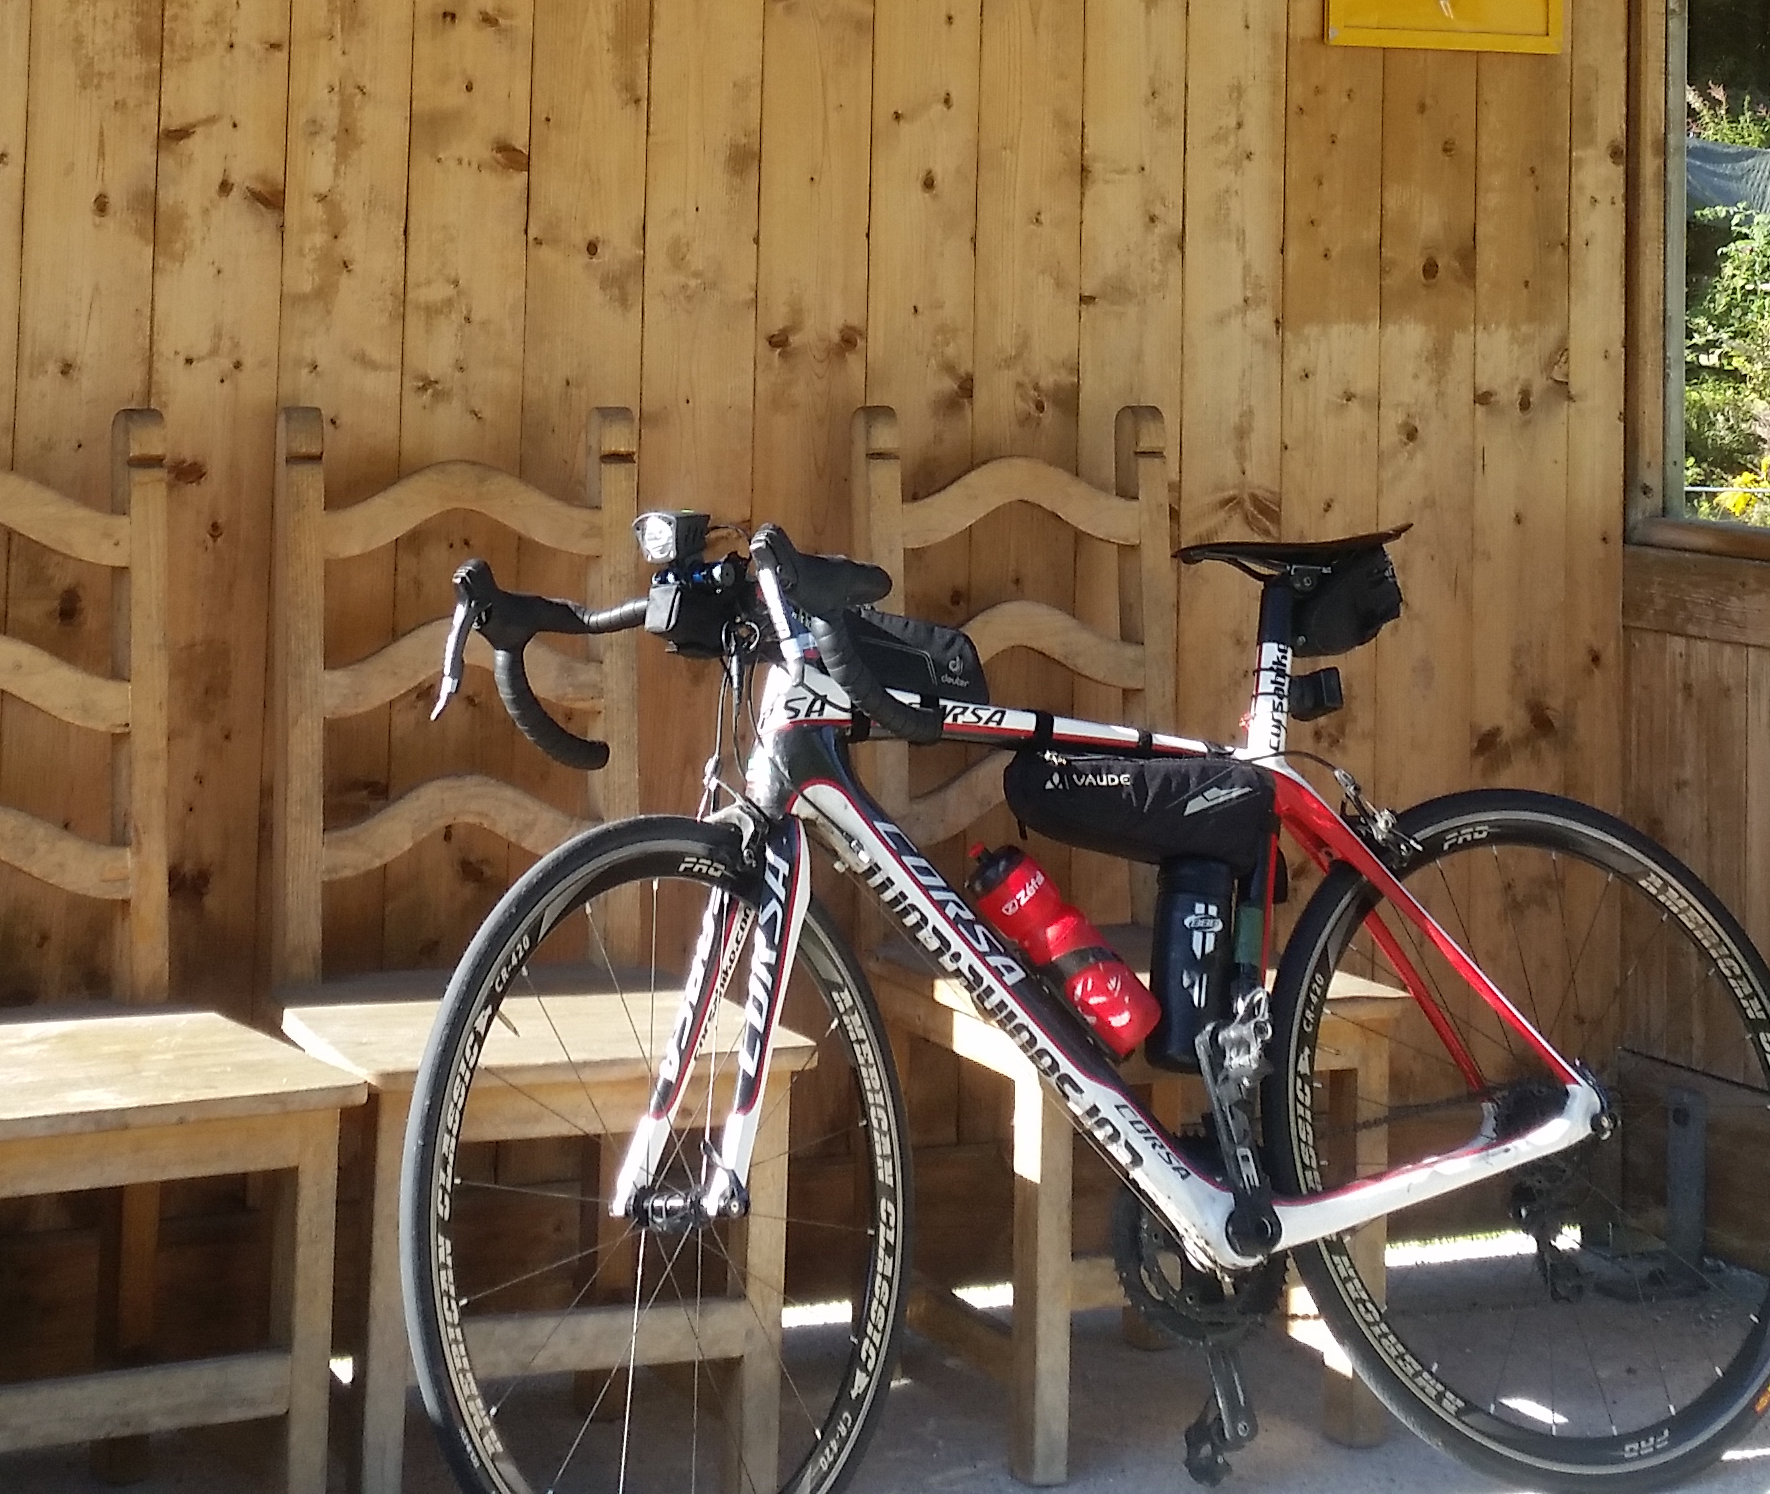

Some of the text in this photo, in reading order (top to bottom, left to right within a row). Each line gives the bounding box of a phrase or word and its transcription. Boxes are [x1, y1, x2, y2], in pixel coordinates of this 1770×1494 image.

[1073, 773, 1131, 787] VAUDE
[493, 935, 531, 994] CR-420
[739, 842, 790, 1079] CORSA
[873, 820, 1026, 987] CORSA
[1302, 972, 1326, 1034] CR-420
[436, 1039, 481, 1221] CLASSIC
[831, 986, 896, 1373] AMERICAN CLASSIC
[1114, 1103, 1192, 1181] CORSA
